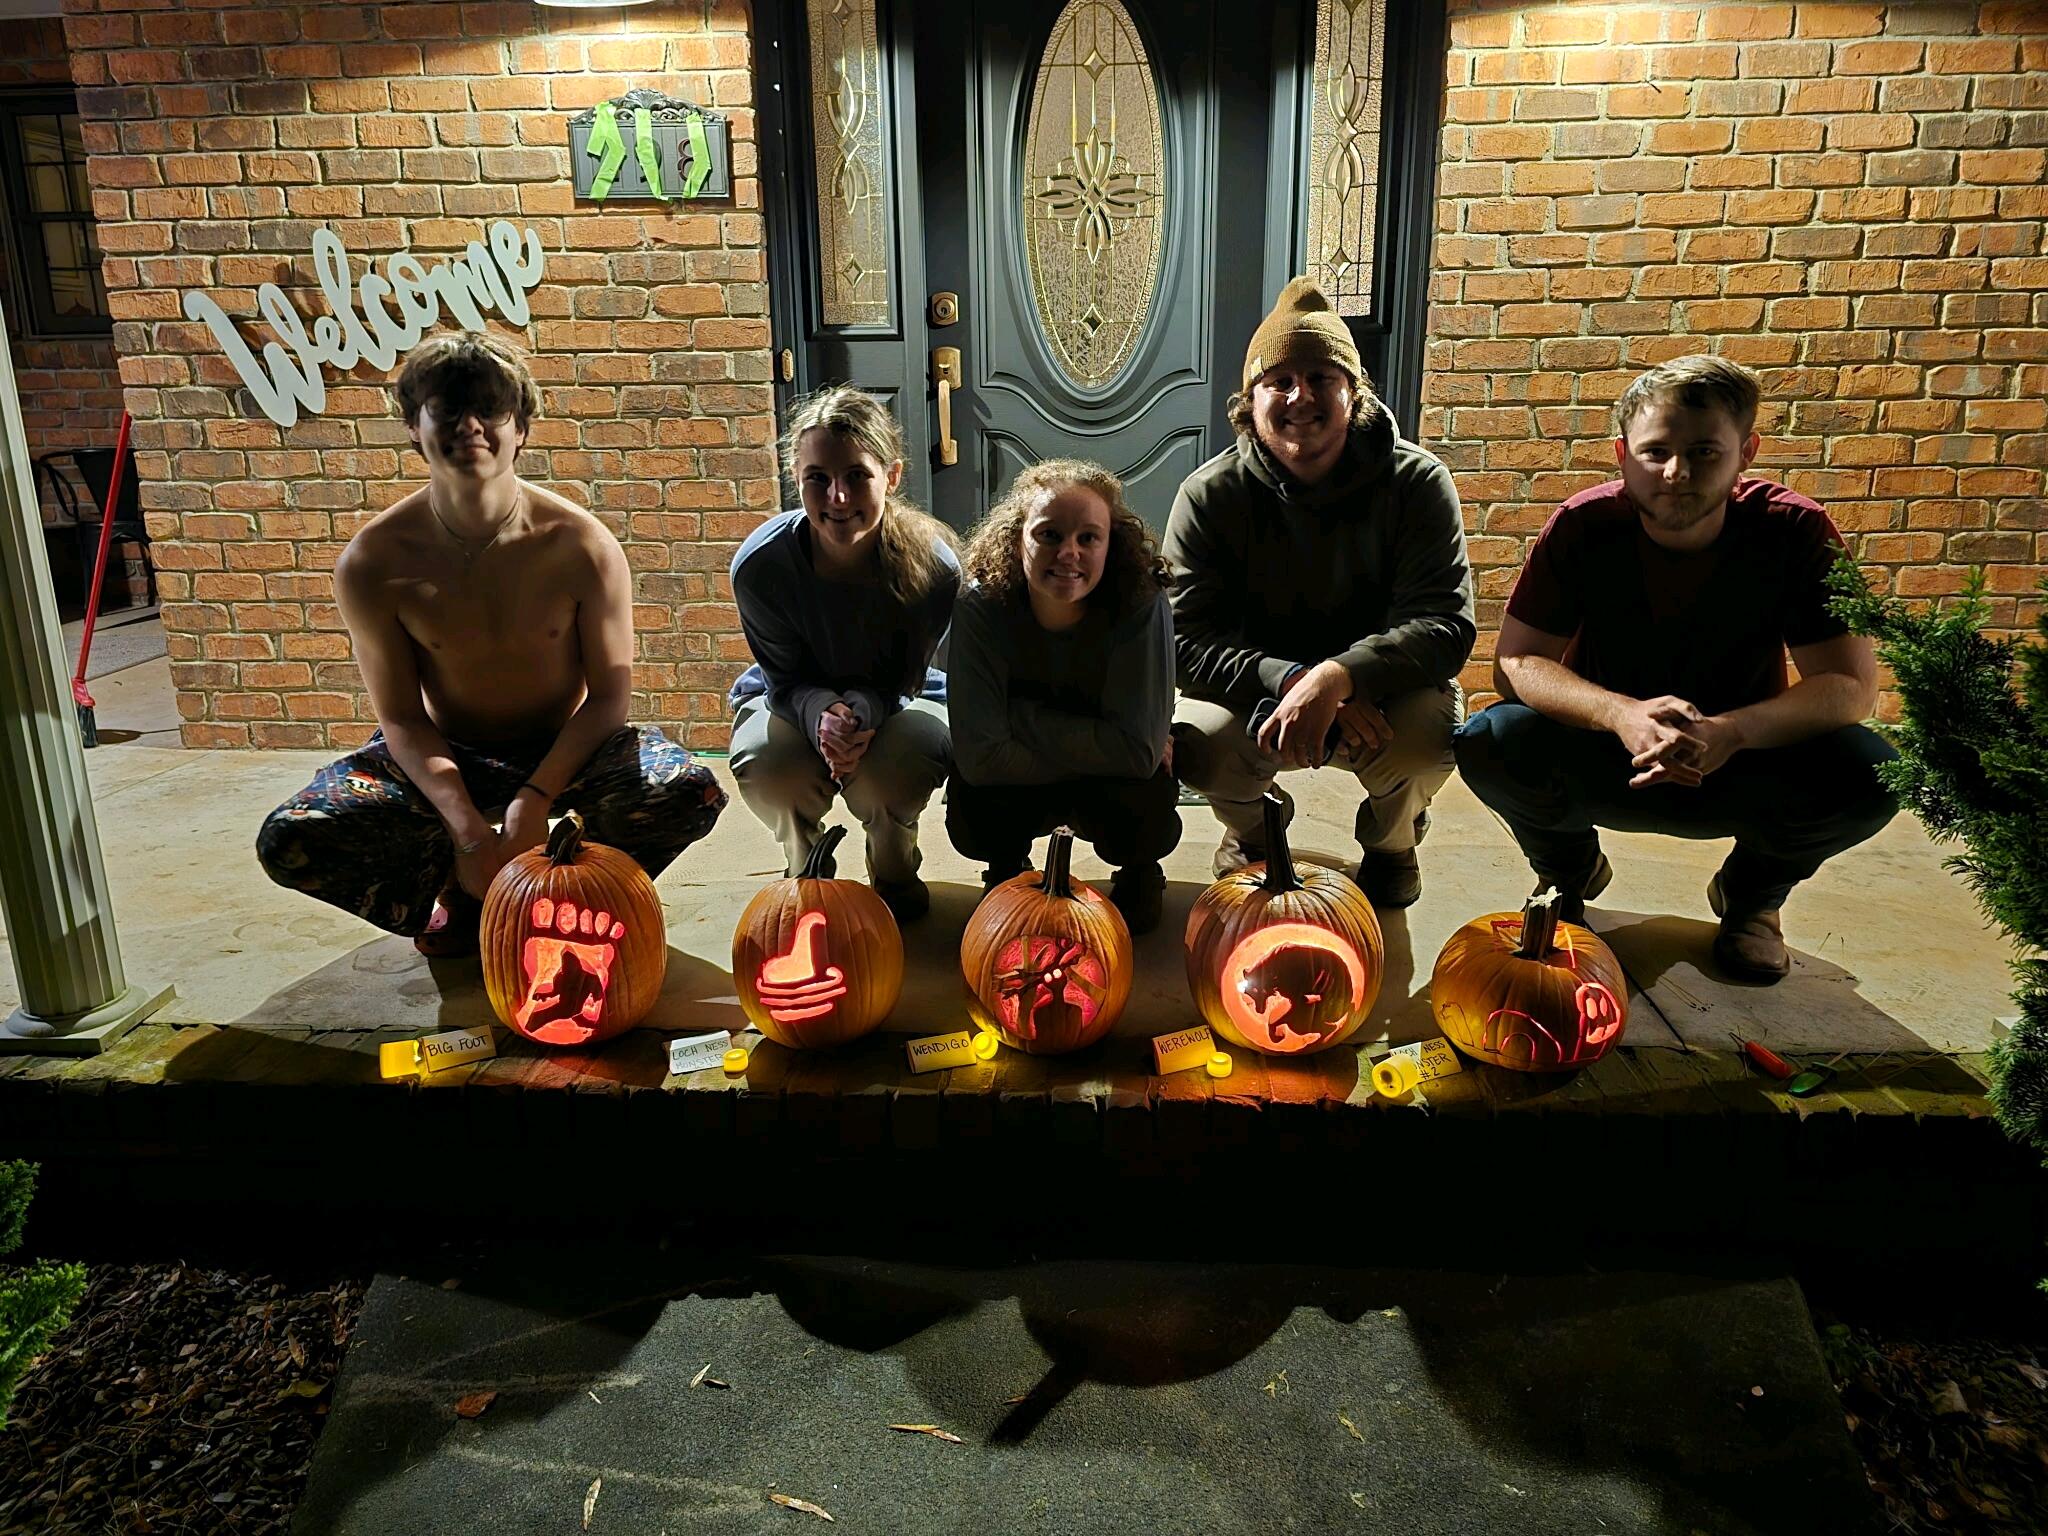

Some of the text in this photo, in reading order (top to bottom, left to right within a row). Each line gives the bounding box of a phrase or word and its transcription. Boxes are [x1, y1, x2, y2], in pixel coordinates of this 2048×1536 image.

[183, 220, 544, 428] Welcome
[427, 1035, 489, 1057] BIG FOOT
[672, 1039, 729, 1060] LOCH NESS
[912, 1038, 969, 1056] WENDIGO
[1423, 1040, 1446, 1054] NESS
[1415, 1052, 1452, 1070] NSTER
